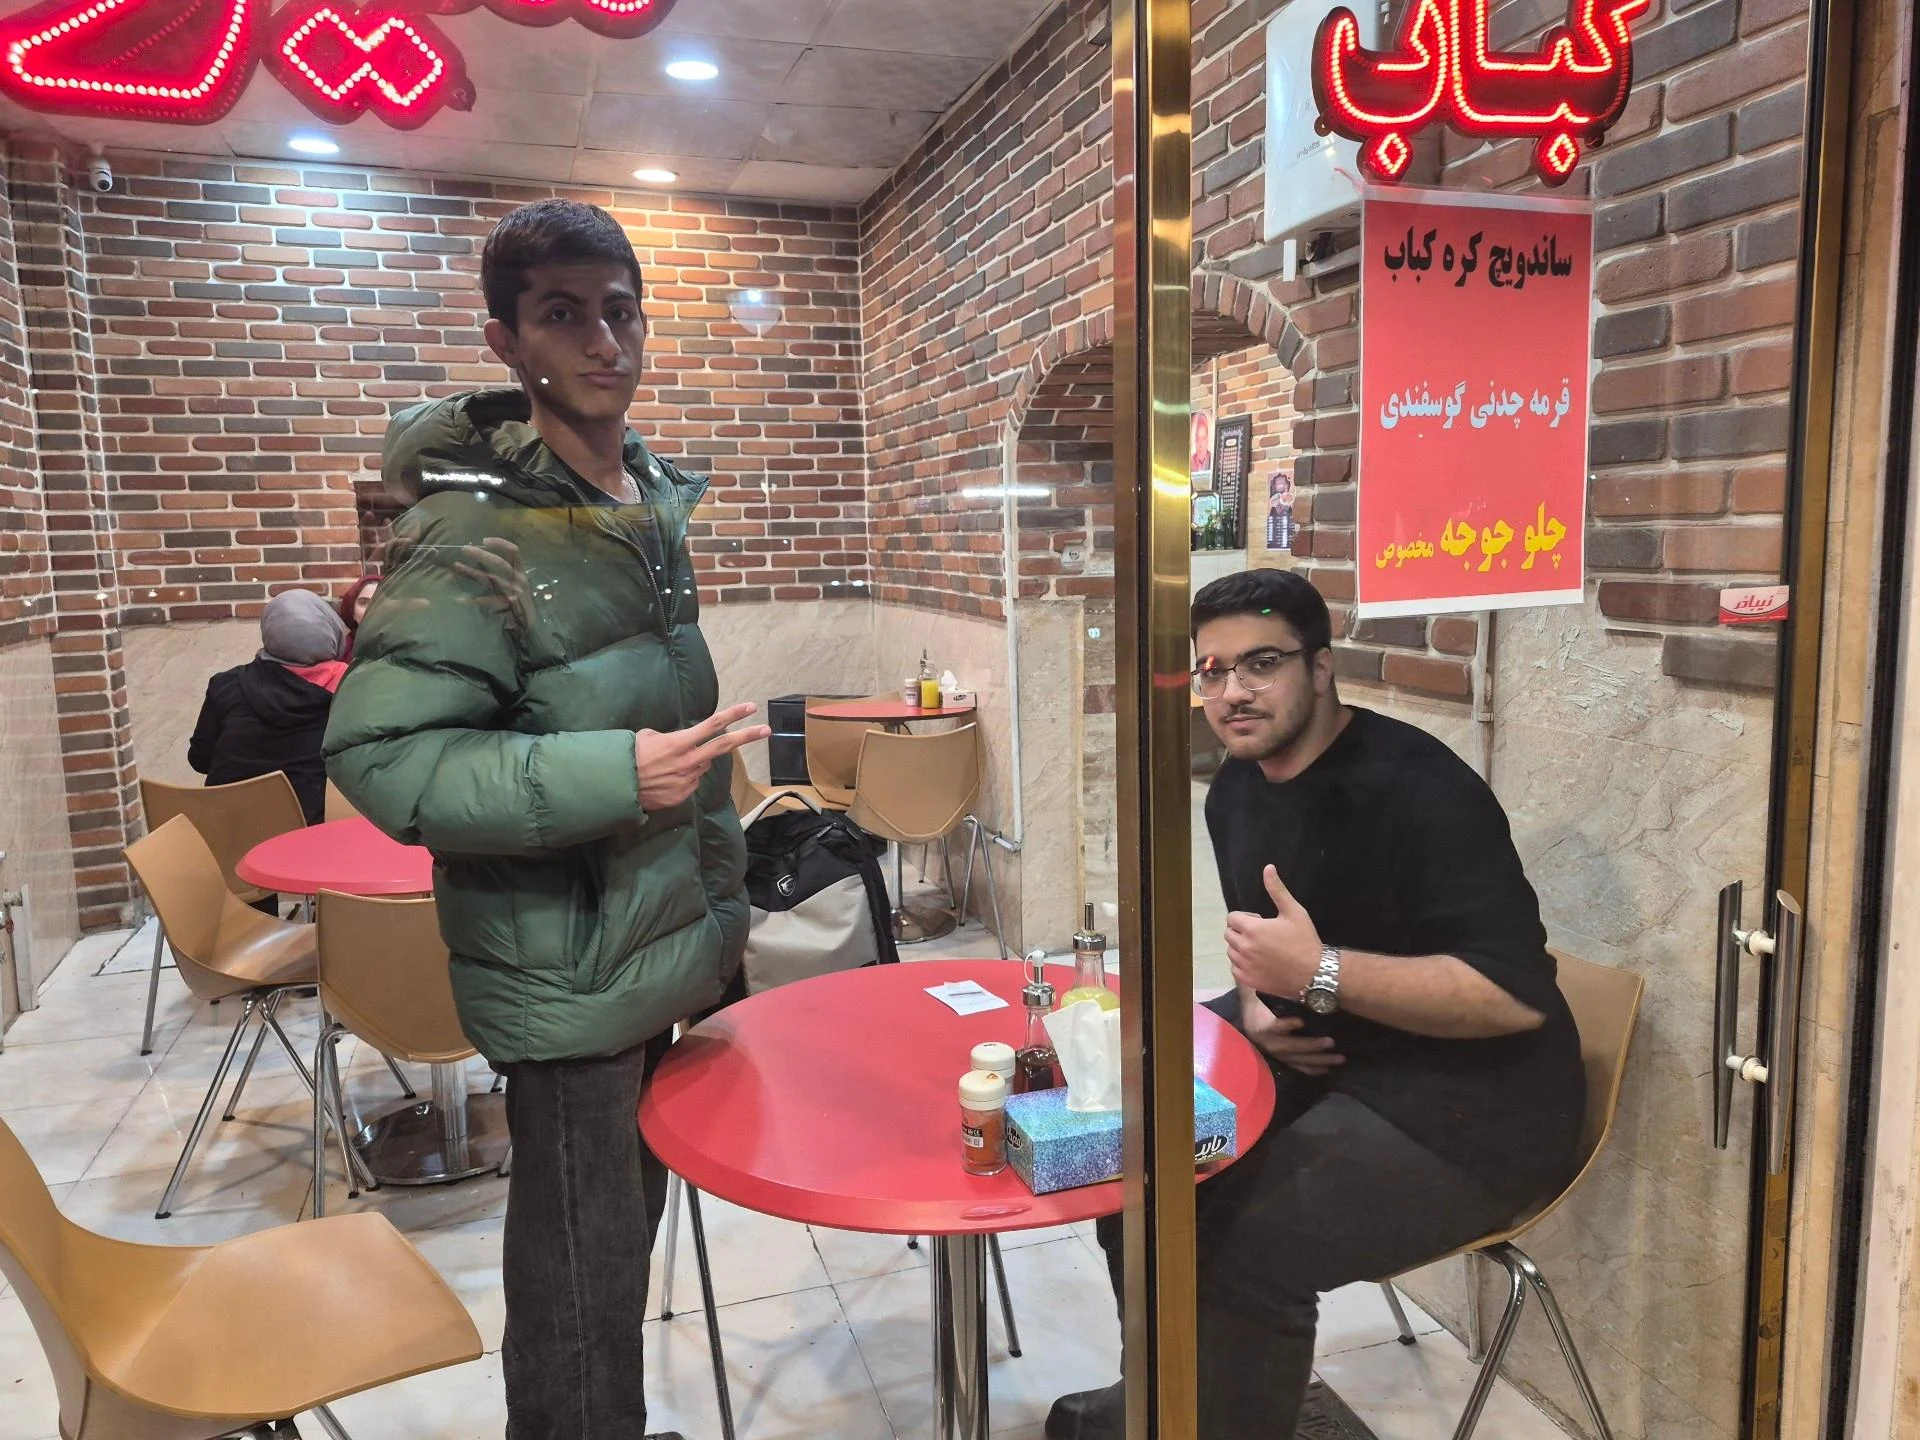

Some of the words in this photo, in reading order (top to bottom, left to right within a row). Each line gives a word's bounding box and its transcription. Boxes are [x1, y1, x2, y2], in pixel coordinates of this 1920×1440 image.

[1324, 0, 1652, 178] کباب
[1384, 226, 1437, 282] کباب
[1443, 231, 1483, 287] کره
[1488, 234, 1573, 289] ساندویچ
[1380, 380, 1467, 429] گوسفندی
[1470, 380, 1524, 429] چدنی
[1529, 377, 1571, 428] قرمه
[1375, 534, 1434, 568] مخصوص
[1440, 517, 1514, 572] جوجه
[1520, 501, 1567, 570] چلو
